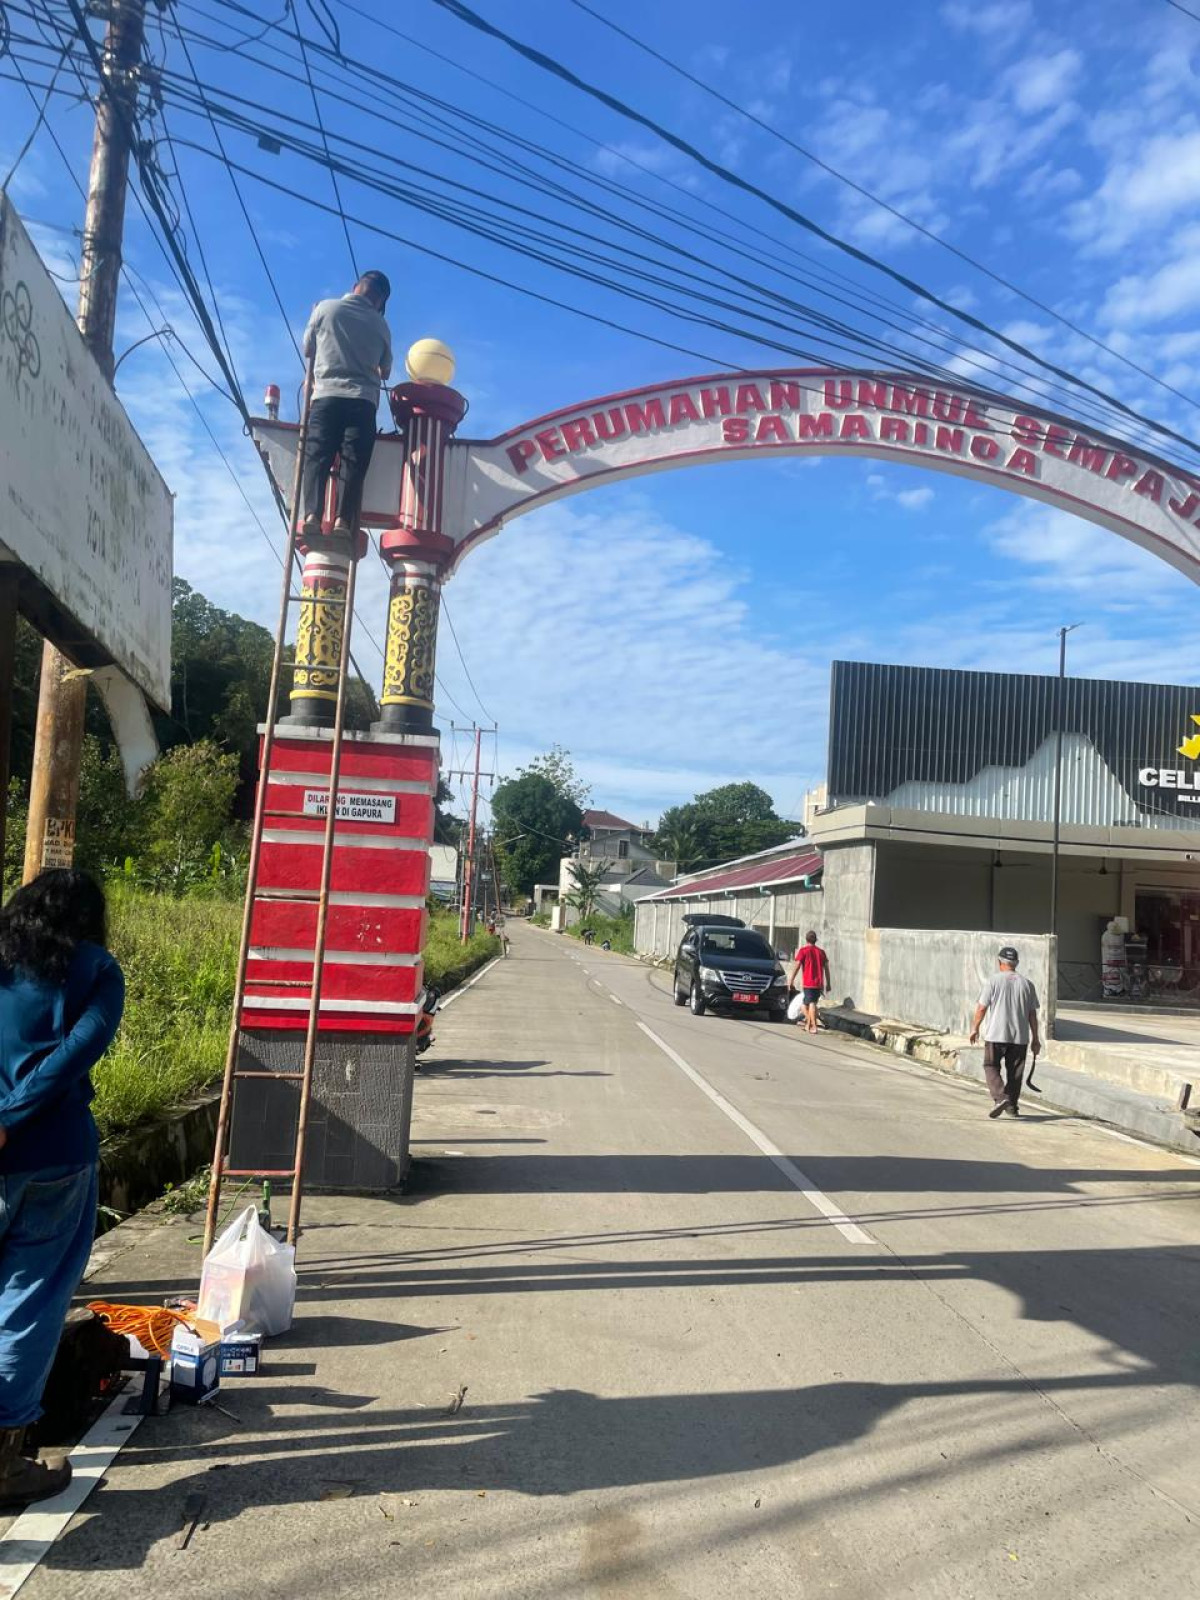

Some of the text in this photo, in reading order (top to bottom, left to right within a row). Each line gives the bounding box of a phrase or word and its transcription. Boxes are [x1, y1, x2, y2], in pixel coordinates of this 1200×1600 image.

[505, 380, 800, 476] PERUMAHAN
[823, 379, 991, 429] UNMUL
[307, 794, 392, 808] DILARNG MEMASANG
[316, 804, 382, 819] IKLN DI GAPURA
